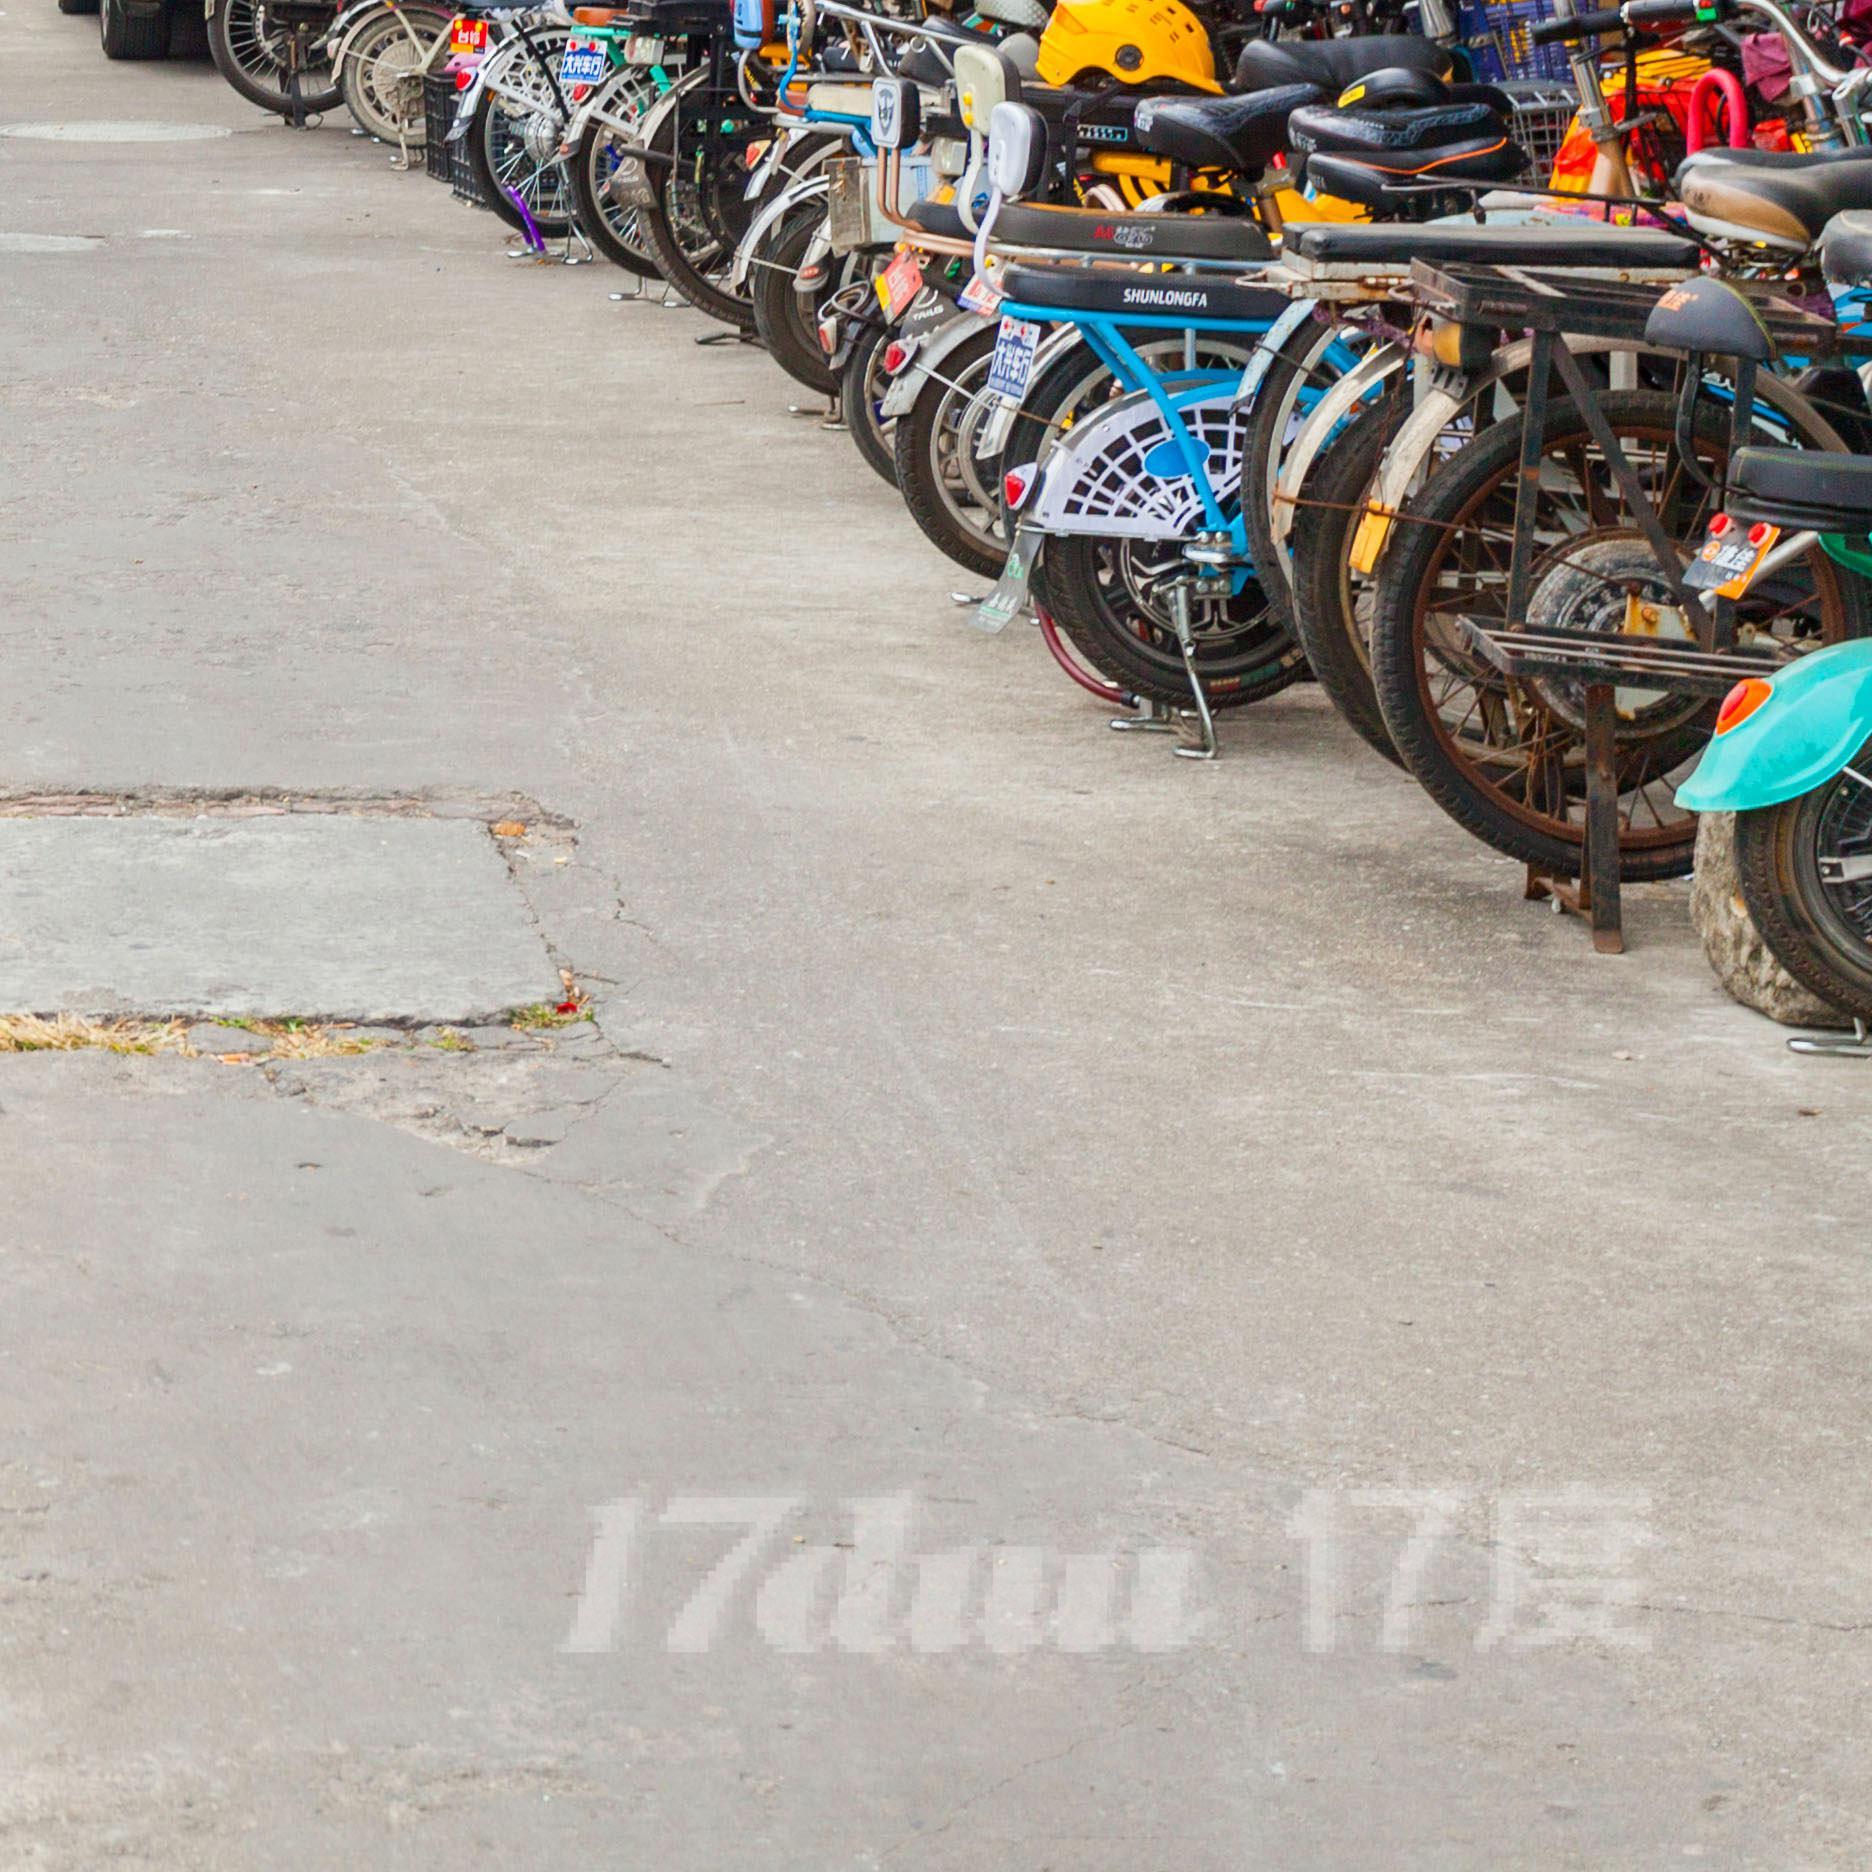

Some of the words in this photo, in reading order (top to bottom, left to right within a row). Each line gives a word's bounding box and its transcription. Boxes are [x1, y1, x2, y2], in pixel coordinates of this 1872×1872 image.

[564, 54, 602, 77] 大兴车行
[1123, 288, 1208, 308] SHUNLONGFA
